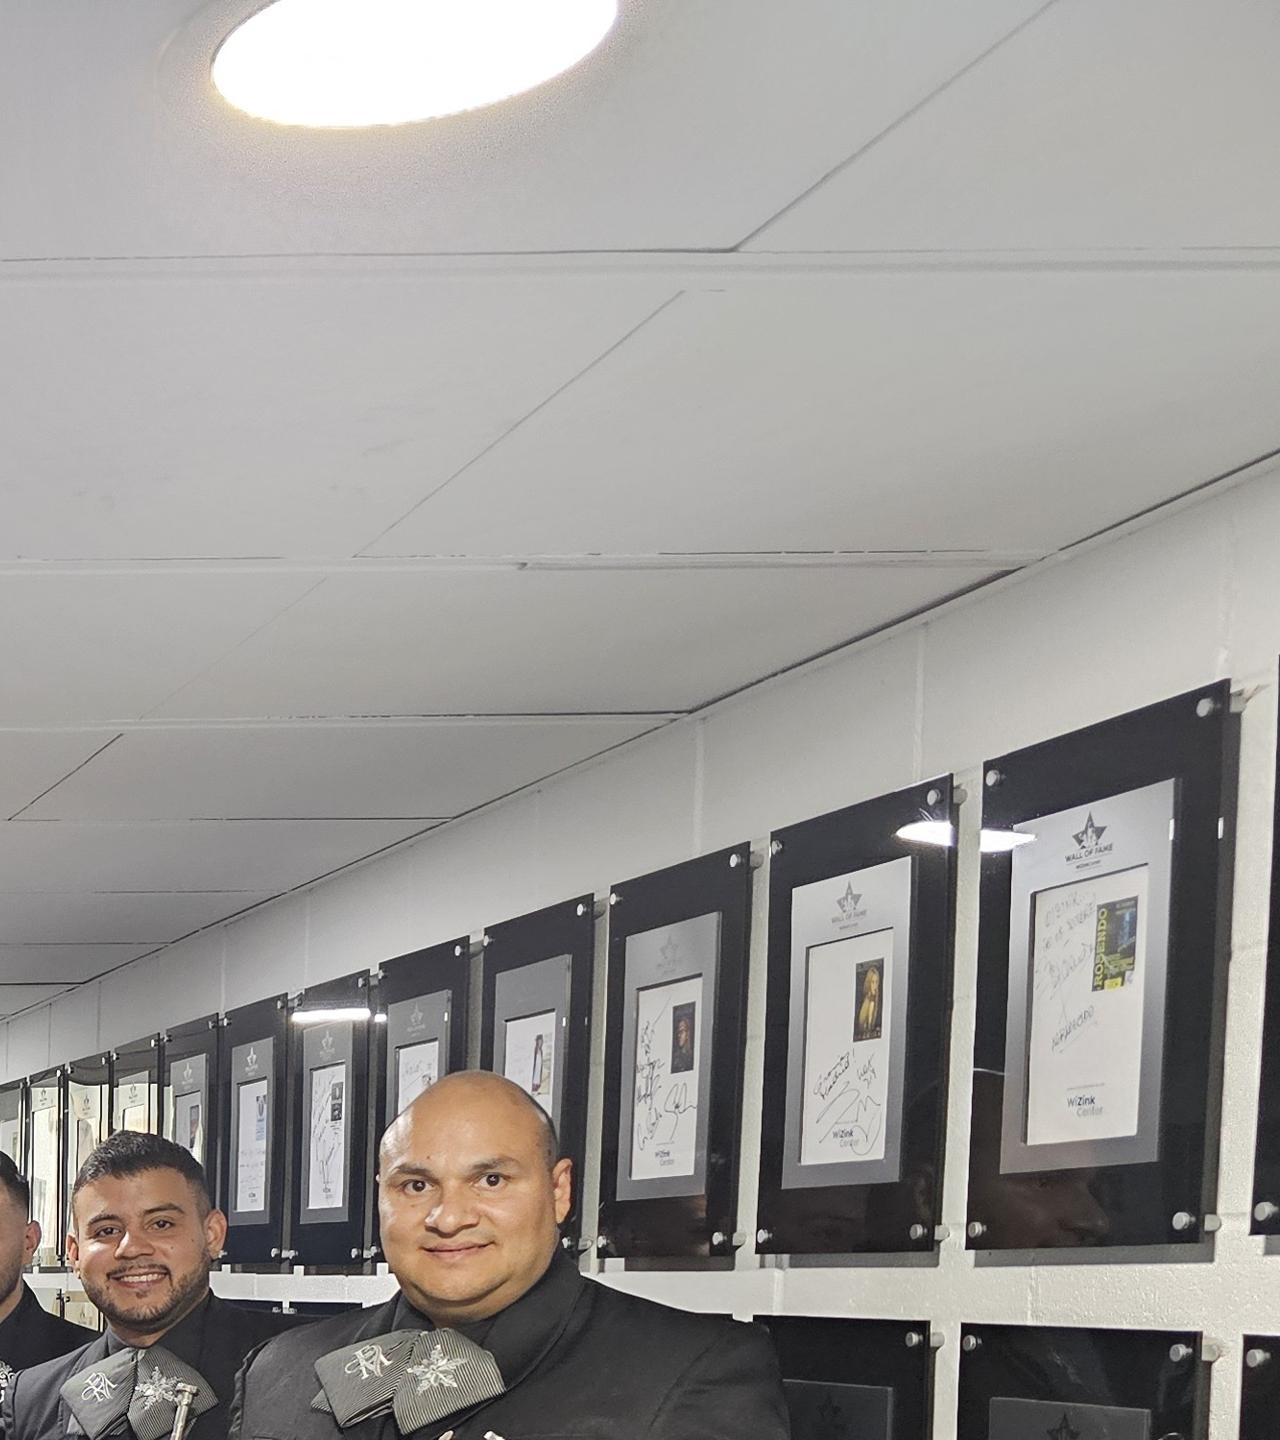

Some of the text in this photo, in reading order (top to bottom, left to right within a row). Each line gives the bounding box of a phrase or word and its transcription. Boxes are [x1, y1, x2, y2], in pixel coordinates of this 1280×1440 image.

[1065, 842, 1113, 862] WALL OF FAME
[1066, 1095, 1096, 1108] WiZink
